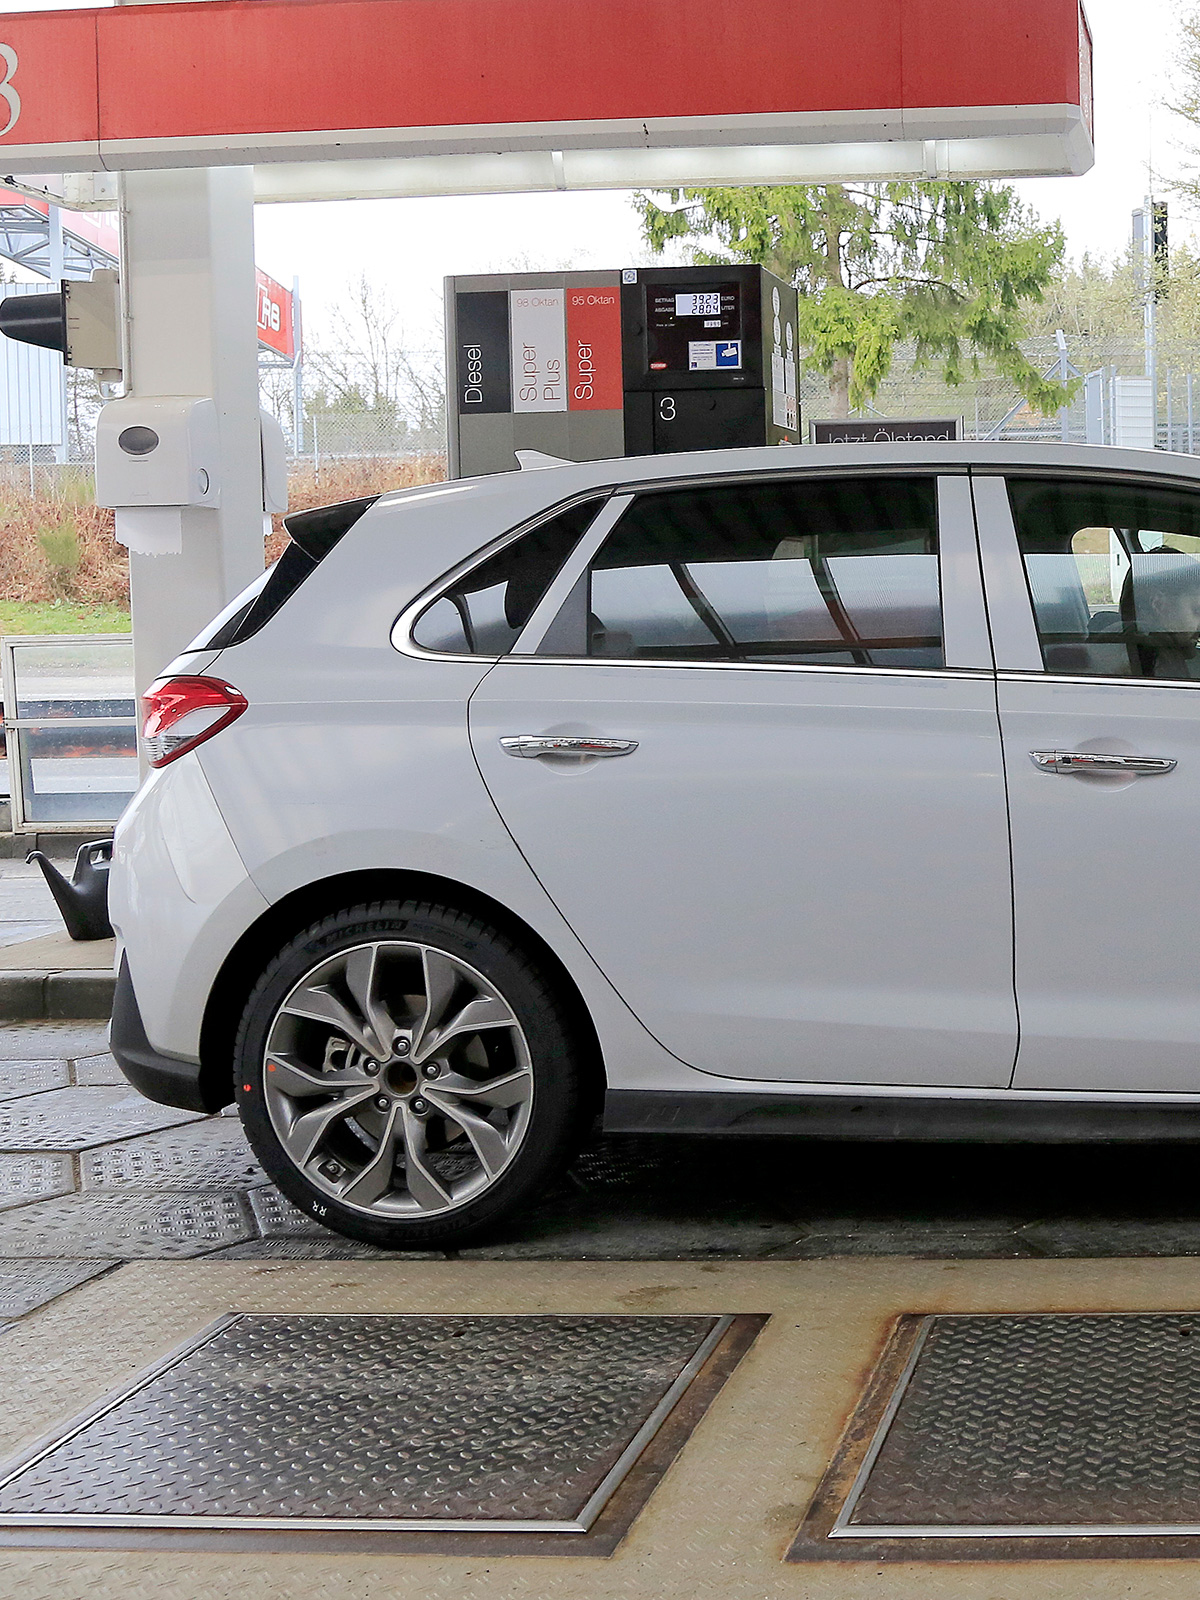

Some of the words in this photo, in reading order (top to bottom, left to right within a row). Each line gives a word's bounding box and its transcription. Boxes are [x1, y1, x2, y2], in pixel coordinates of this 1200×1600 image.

[516, 298, 529, 308] 98
[531, 297, 560, 308] Oktan
[571, 296, 584, 306] 95
[586, 295, 615, 306] Oktan
[463, 344, 483, 404] Diesel
[519, 342, 540, 402] Super
[543, 359, 561, 401] Plus
[574, 340, 597, 400] Super
[660, 397, 676, 421] 3
[325, 919, 403, 944] MICHELIN
